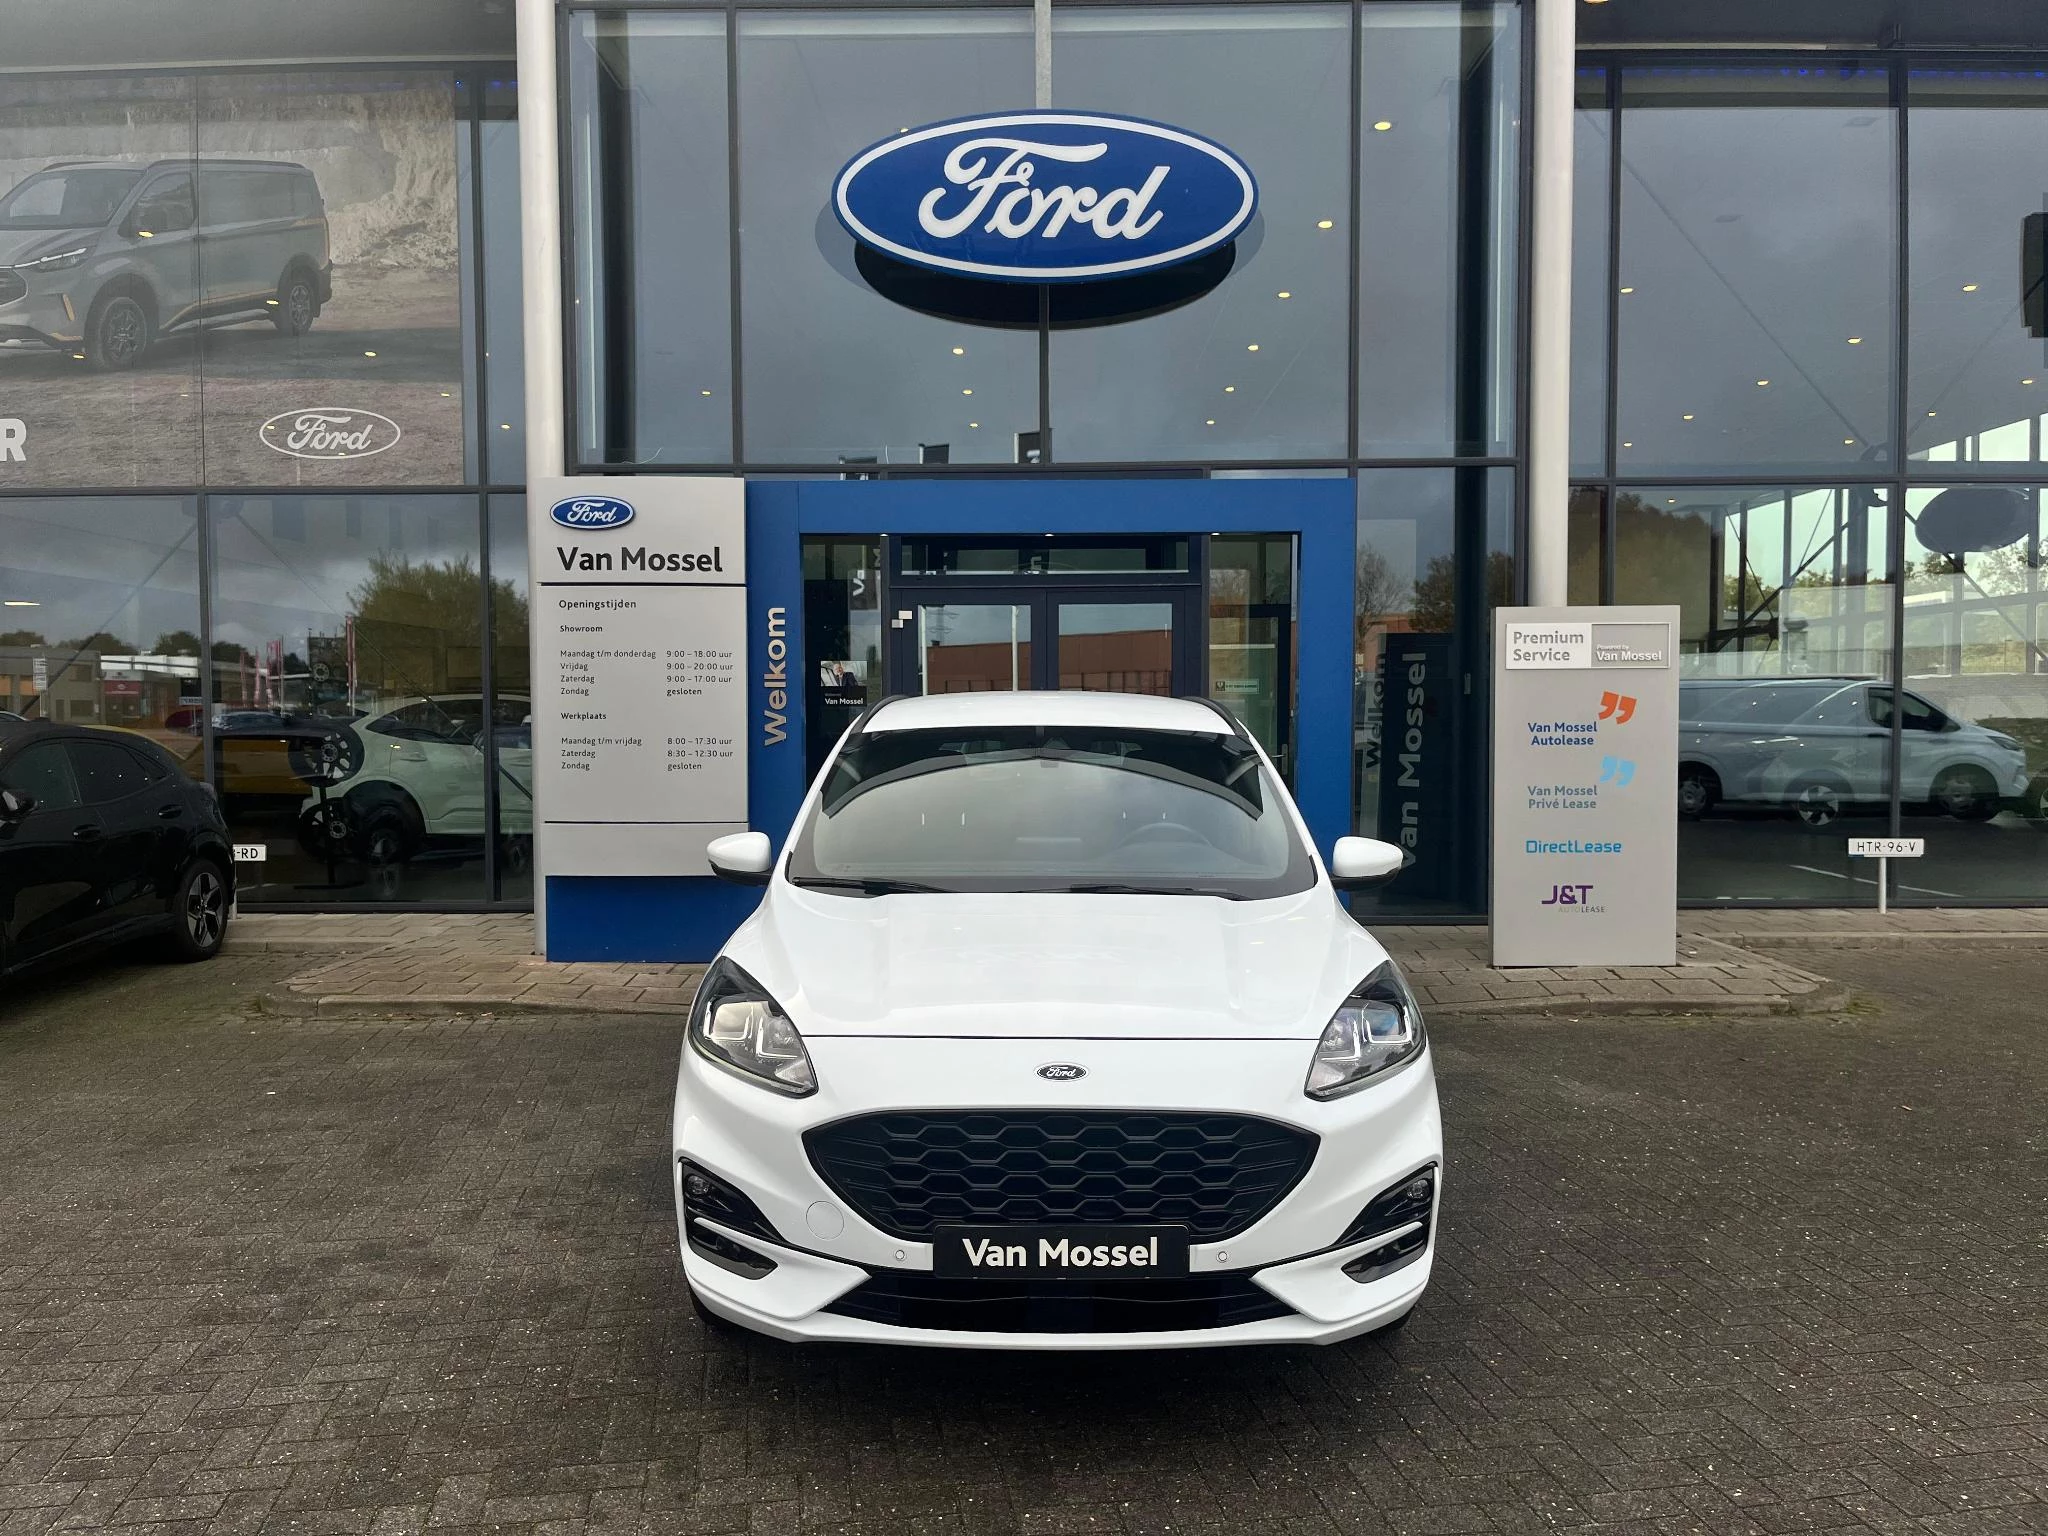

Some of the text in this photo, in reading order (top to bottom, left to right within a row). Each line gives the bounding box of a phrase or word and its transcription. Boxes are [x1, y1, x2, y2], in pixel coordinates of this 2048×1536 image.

[919, 138, 1171, 240] Ford
[287, 414, 373, 450] Ford
[567, 500, 617, 523] Ford
[556, 546, 723, 572] Van Mossel
[558, 599, 637, 611] Openingstijden
[559, 624, 603, 633] Showroom
[1513, 630, 1585, 645] Premium
[560, 650, 595, 660] Maandag
[597, 650, 612, 658] t/m
[613, 650, 657, 660] donderdag
[1513, 647, 1571, 662] Service
[1596, 650, 1663, 662] Van Mossel
[560, 662, 589, 672] Vrijdag
[560, 675, 595, 685] Zaterdag
[764, 607, 787, 747] Welkom
[560, 687, 702, 697] Zondag gesloten
[560, 712, 607, 721] Werkplaats
[1365, 653, 1386, 769] Welkom
[1528, 721, 1598, 733] Van Mossel
[561, 737, 596, 746] Maandag
[597, 737, 613, 745] t/m
[614, 737, 643, 746] vrijdag
[1531, 735, 1594, 746] Autolease
[561, 749, 596, 759] Zaterdag
[561, 761, 702, 772] Zondag gesloten
[1397, 652, 1427, 870] Van Mossel
[1527, 785, 1598, 796] Van Mossel
[1528, 798, 1597, 809] Privé Lease
[1526, 840, 1622, 853] DirectLease
[1857, 841, 1916, 853] HTR-96-V
[1541, 885, 1594, 905] J&T
[962, 1236, 1158, 1267] Van Mossel
